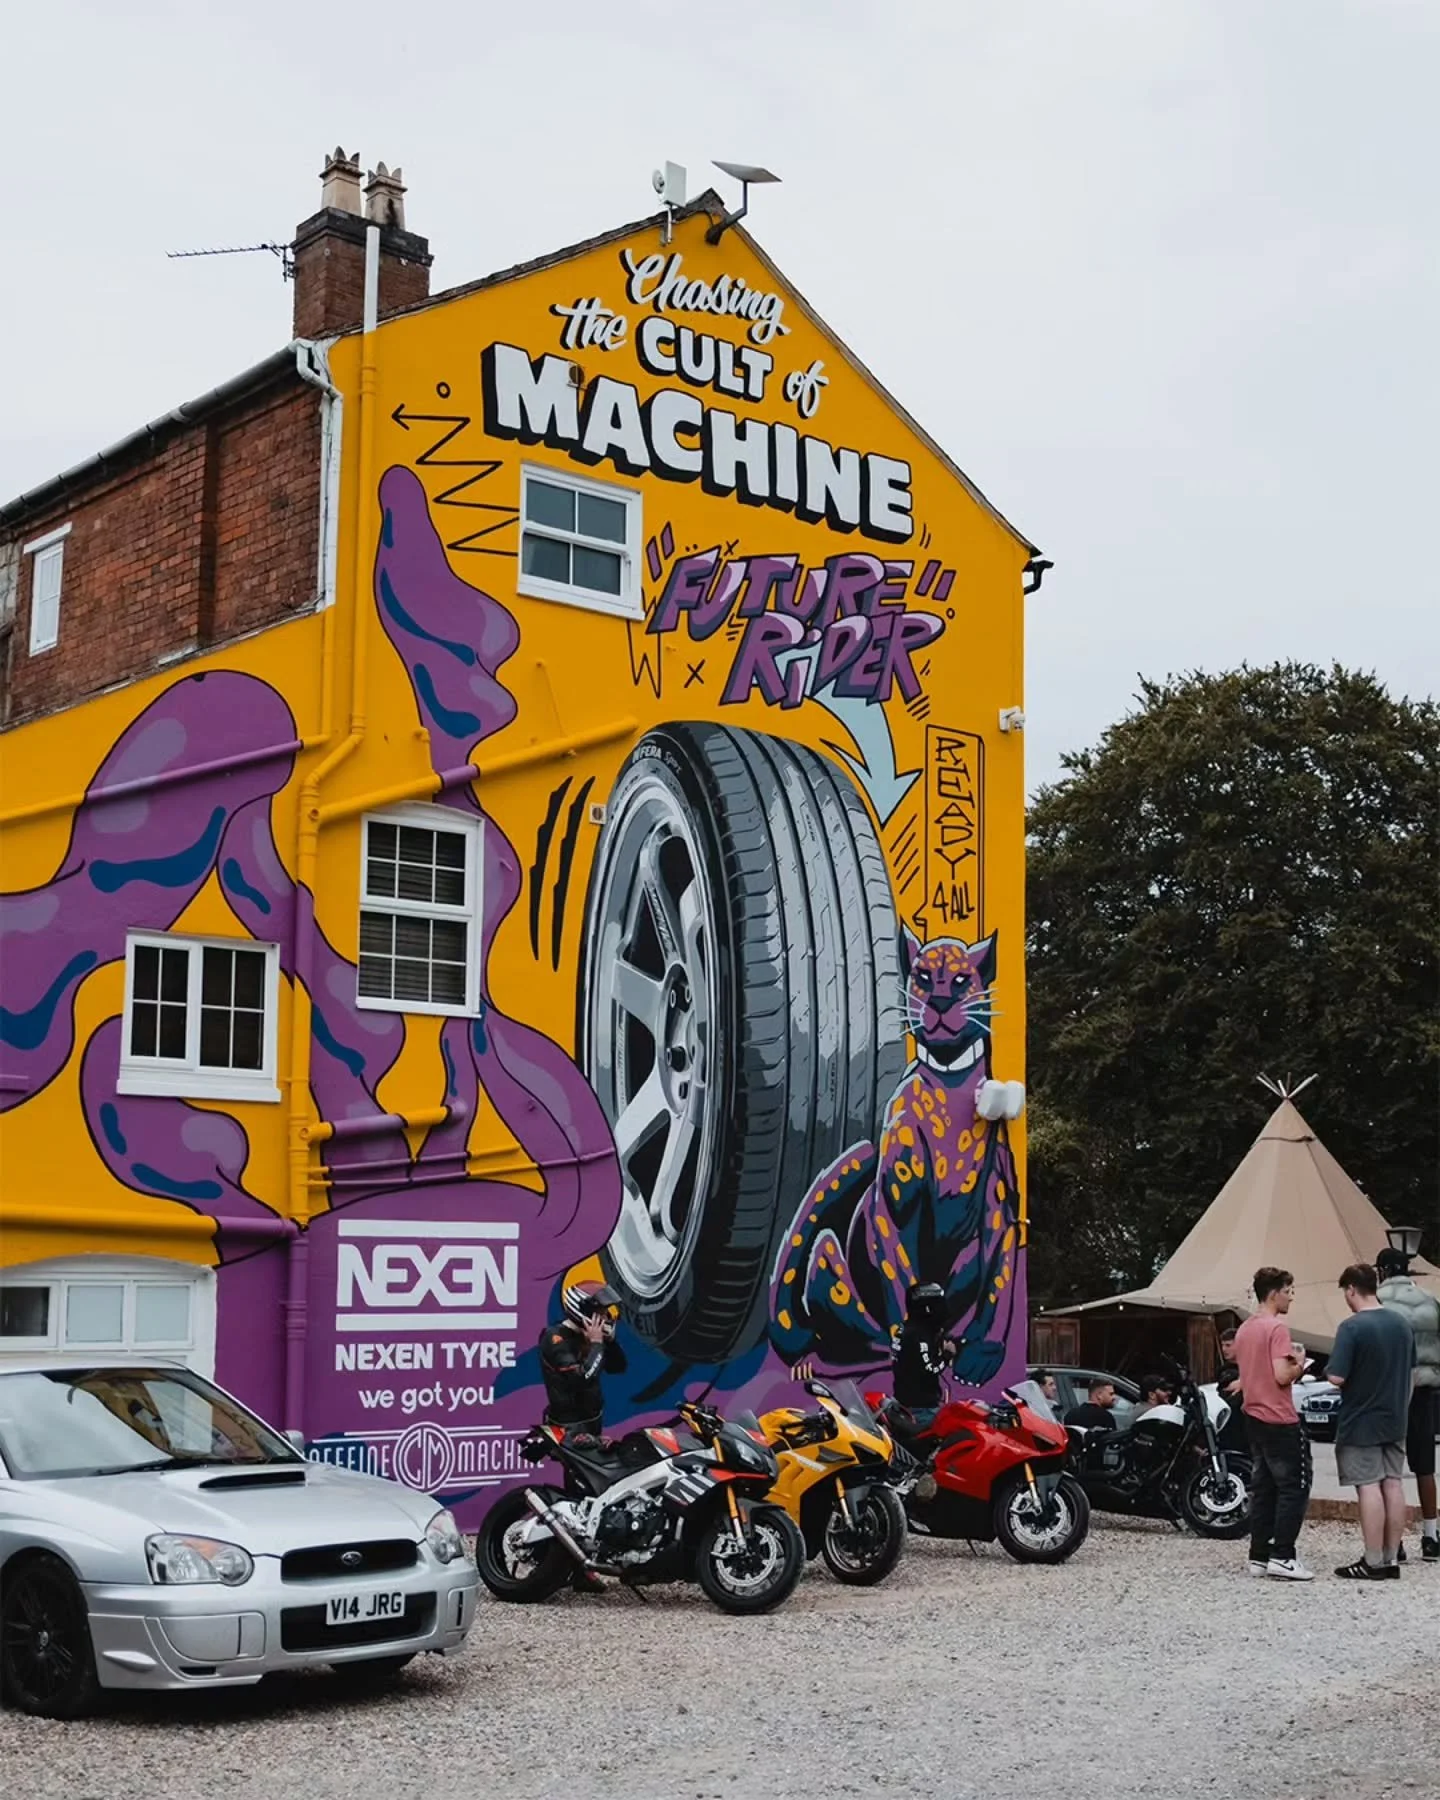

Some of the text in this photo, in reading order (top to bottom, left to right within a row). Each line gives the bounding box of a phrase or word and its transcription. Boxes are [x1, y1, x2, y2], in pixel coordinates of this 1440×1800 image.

[620, 248, 791, 345] Chasing
[551, 298, 829, 418] the CULT of
[482, 342, 914, 546] MACHINE
[934, 736, 977, 880] READY
[337, 1243, 518, 1306] NEXEN
[335, 1341, 517, 1371] NEXEN TYRE
[358, 1381, 494, 1414] we got you
[458, 1439, 545, 1472] MACHI
[330, 1591, 402, 1621] V14 JRG
